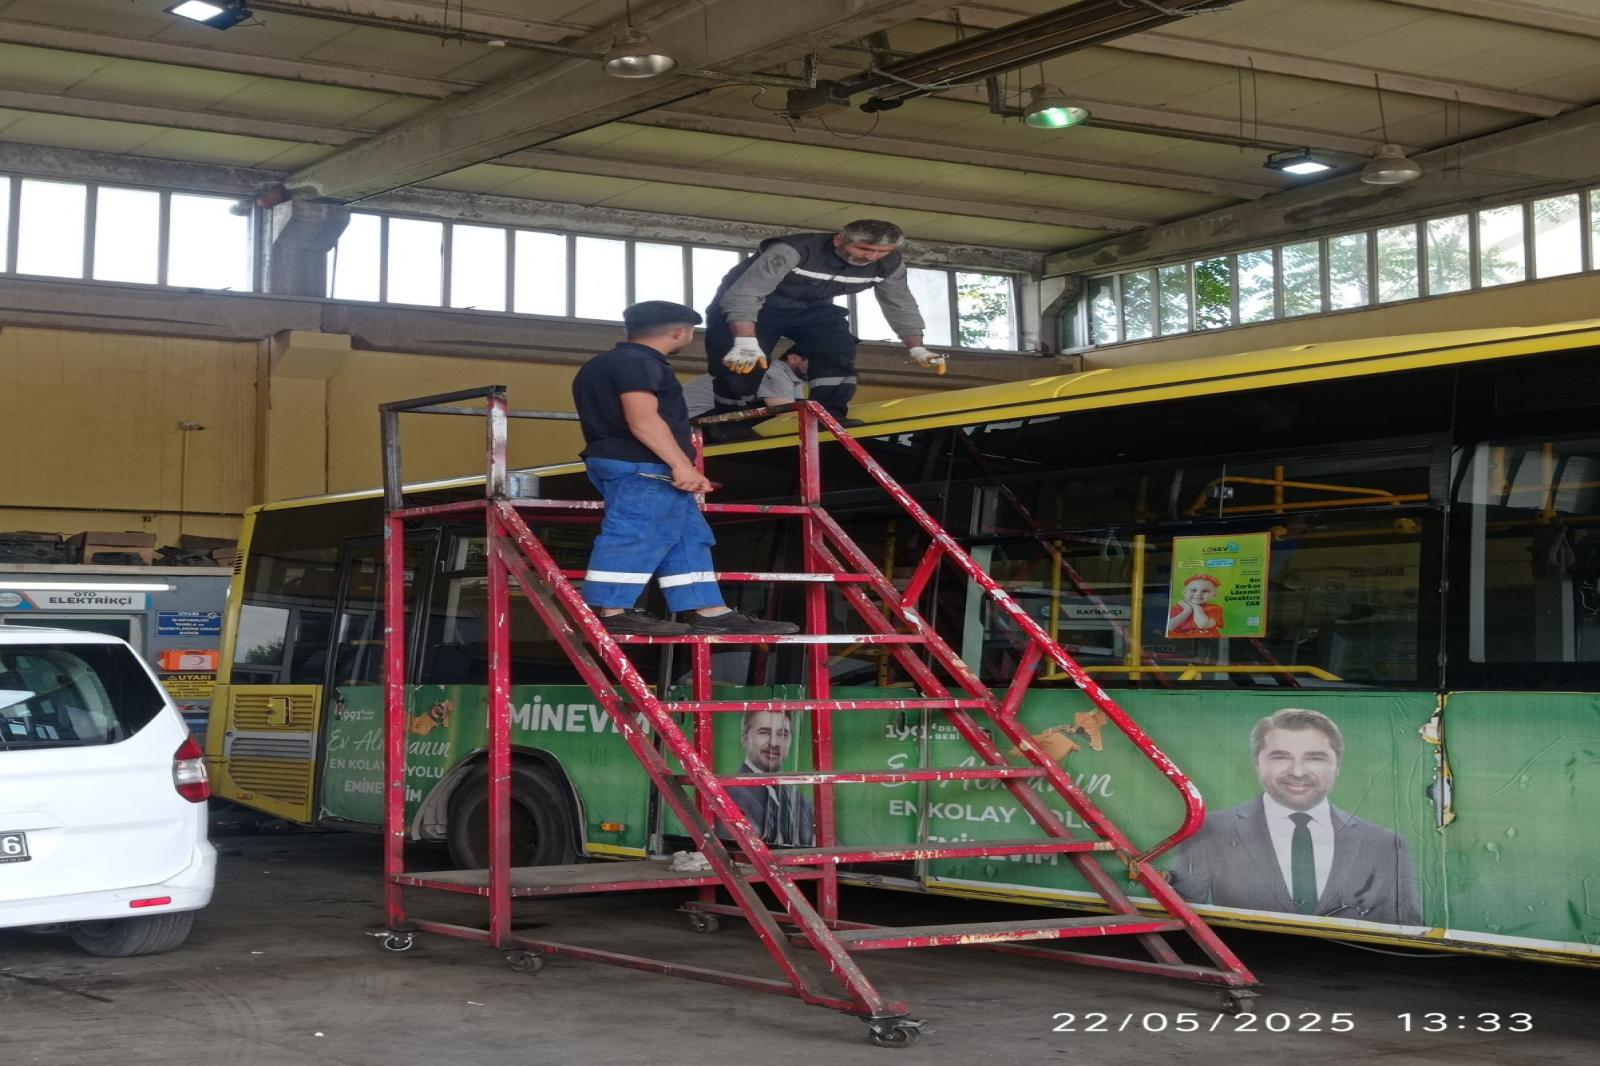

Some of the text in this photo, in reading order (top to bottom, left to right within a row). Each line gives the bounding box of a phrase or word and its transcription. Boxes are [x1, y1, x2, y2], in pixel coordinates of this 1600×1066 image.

[329, 758, 346, 769] EN
[406, 765, 444, 778] YOLU
[344, 777, 422, 802] EMİNEİM
[888, 800, 918, 817] EN
[928, 803, 1016, 824] KOLAY
